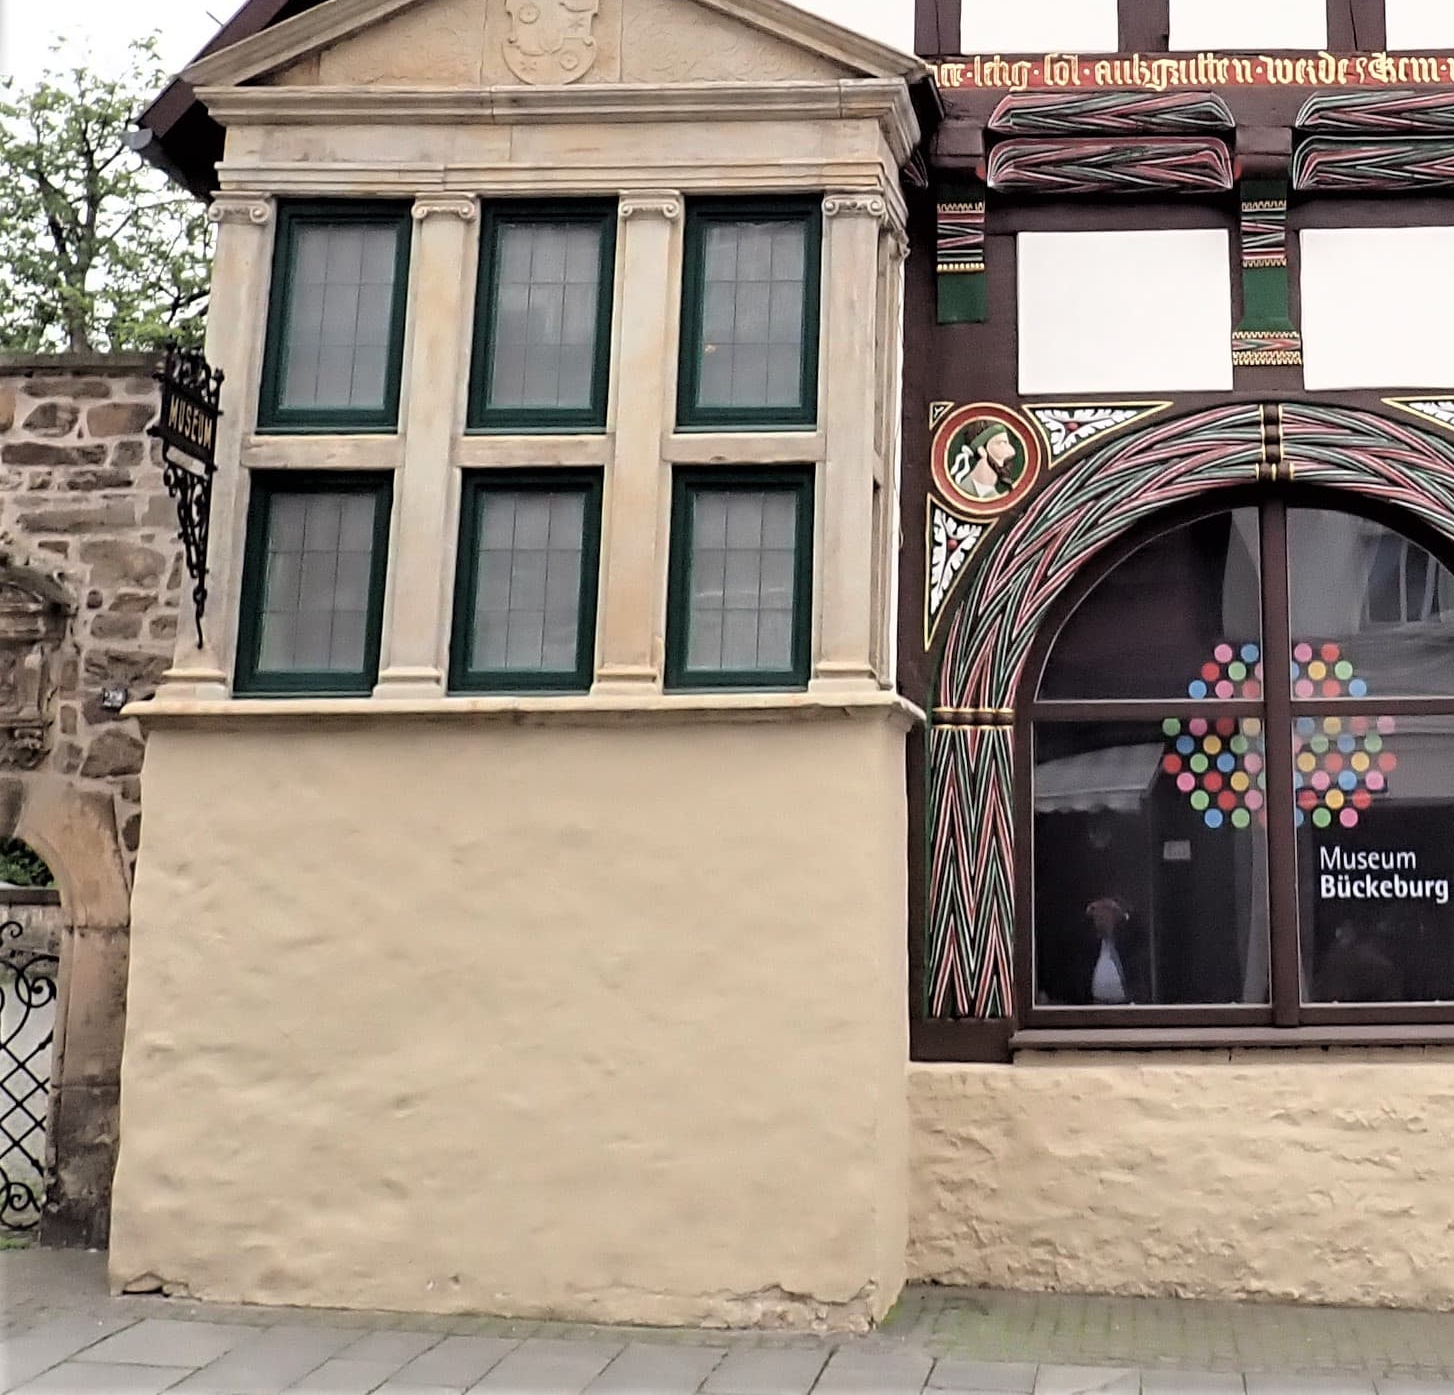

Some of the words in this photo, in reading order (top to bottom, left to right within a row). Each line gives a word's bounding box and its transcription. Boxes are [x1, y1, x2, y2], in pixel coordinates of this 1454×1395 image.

[168, 394, 213, 450] MUSEUM
[1320, 846, 1417, 870] Museum
[1320, 874, 1449, 904] Bückeburg
